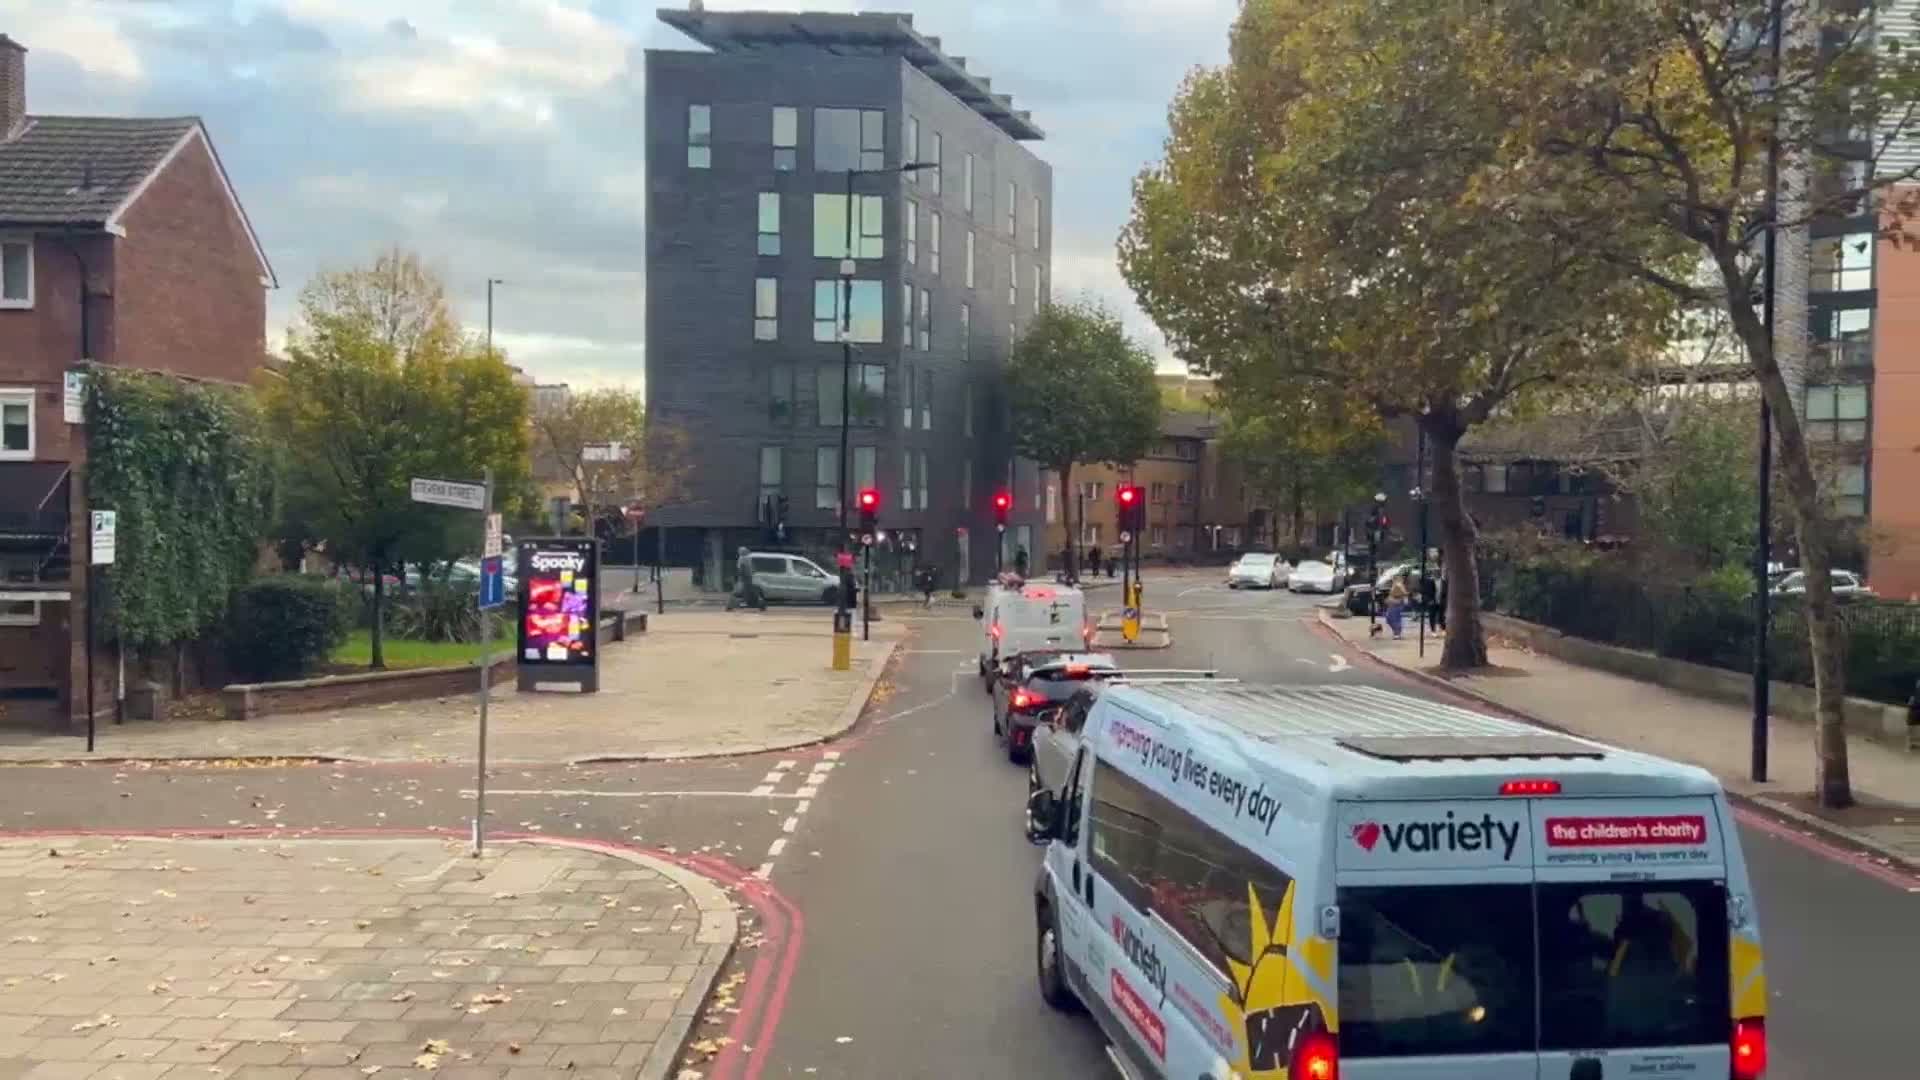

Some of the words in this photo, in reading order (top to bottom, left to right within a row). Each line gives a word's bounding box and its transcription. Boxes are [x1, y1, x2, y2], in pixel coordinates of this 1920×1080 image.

[448, 486, 477, 500] STREET
[531, 554, 584, 572] Spooky
[1109, 719, 1152, 766] improving
[1150, 743, 1183, 783] young
[1182, 748, 1208, 790] lives
[1210, 770, 1247, 817] every
[1247, 782, 1282, 836] day
[1383, 810, 1520, 861] variety
[1552, 824, 1577, 839] the
[1580, 823, 1648, 839] children's
[1651, 822, 1700, 839] charity
[1120, 922, 1167, 1009] variety
